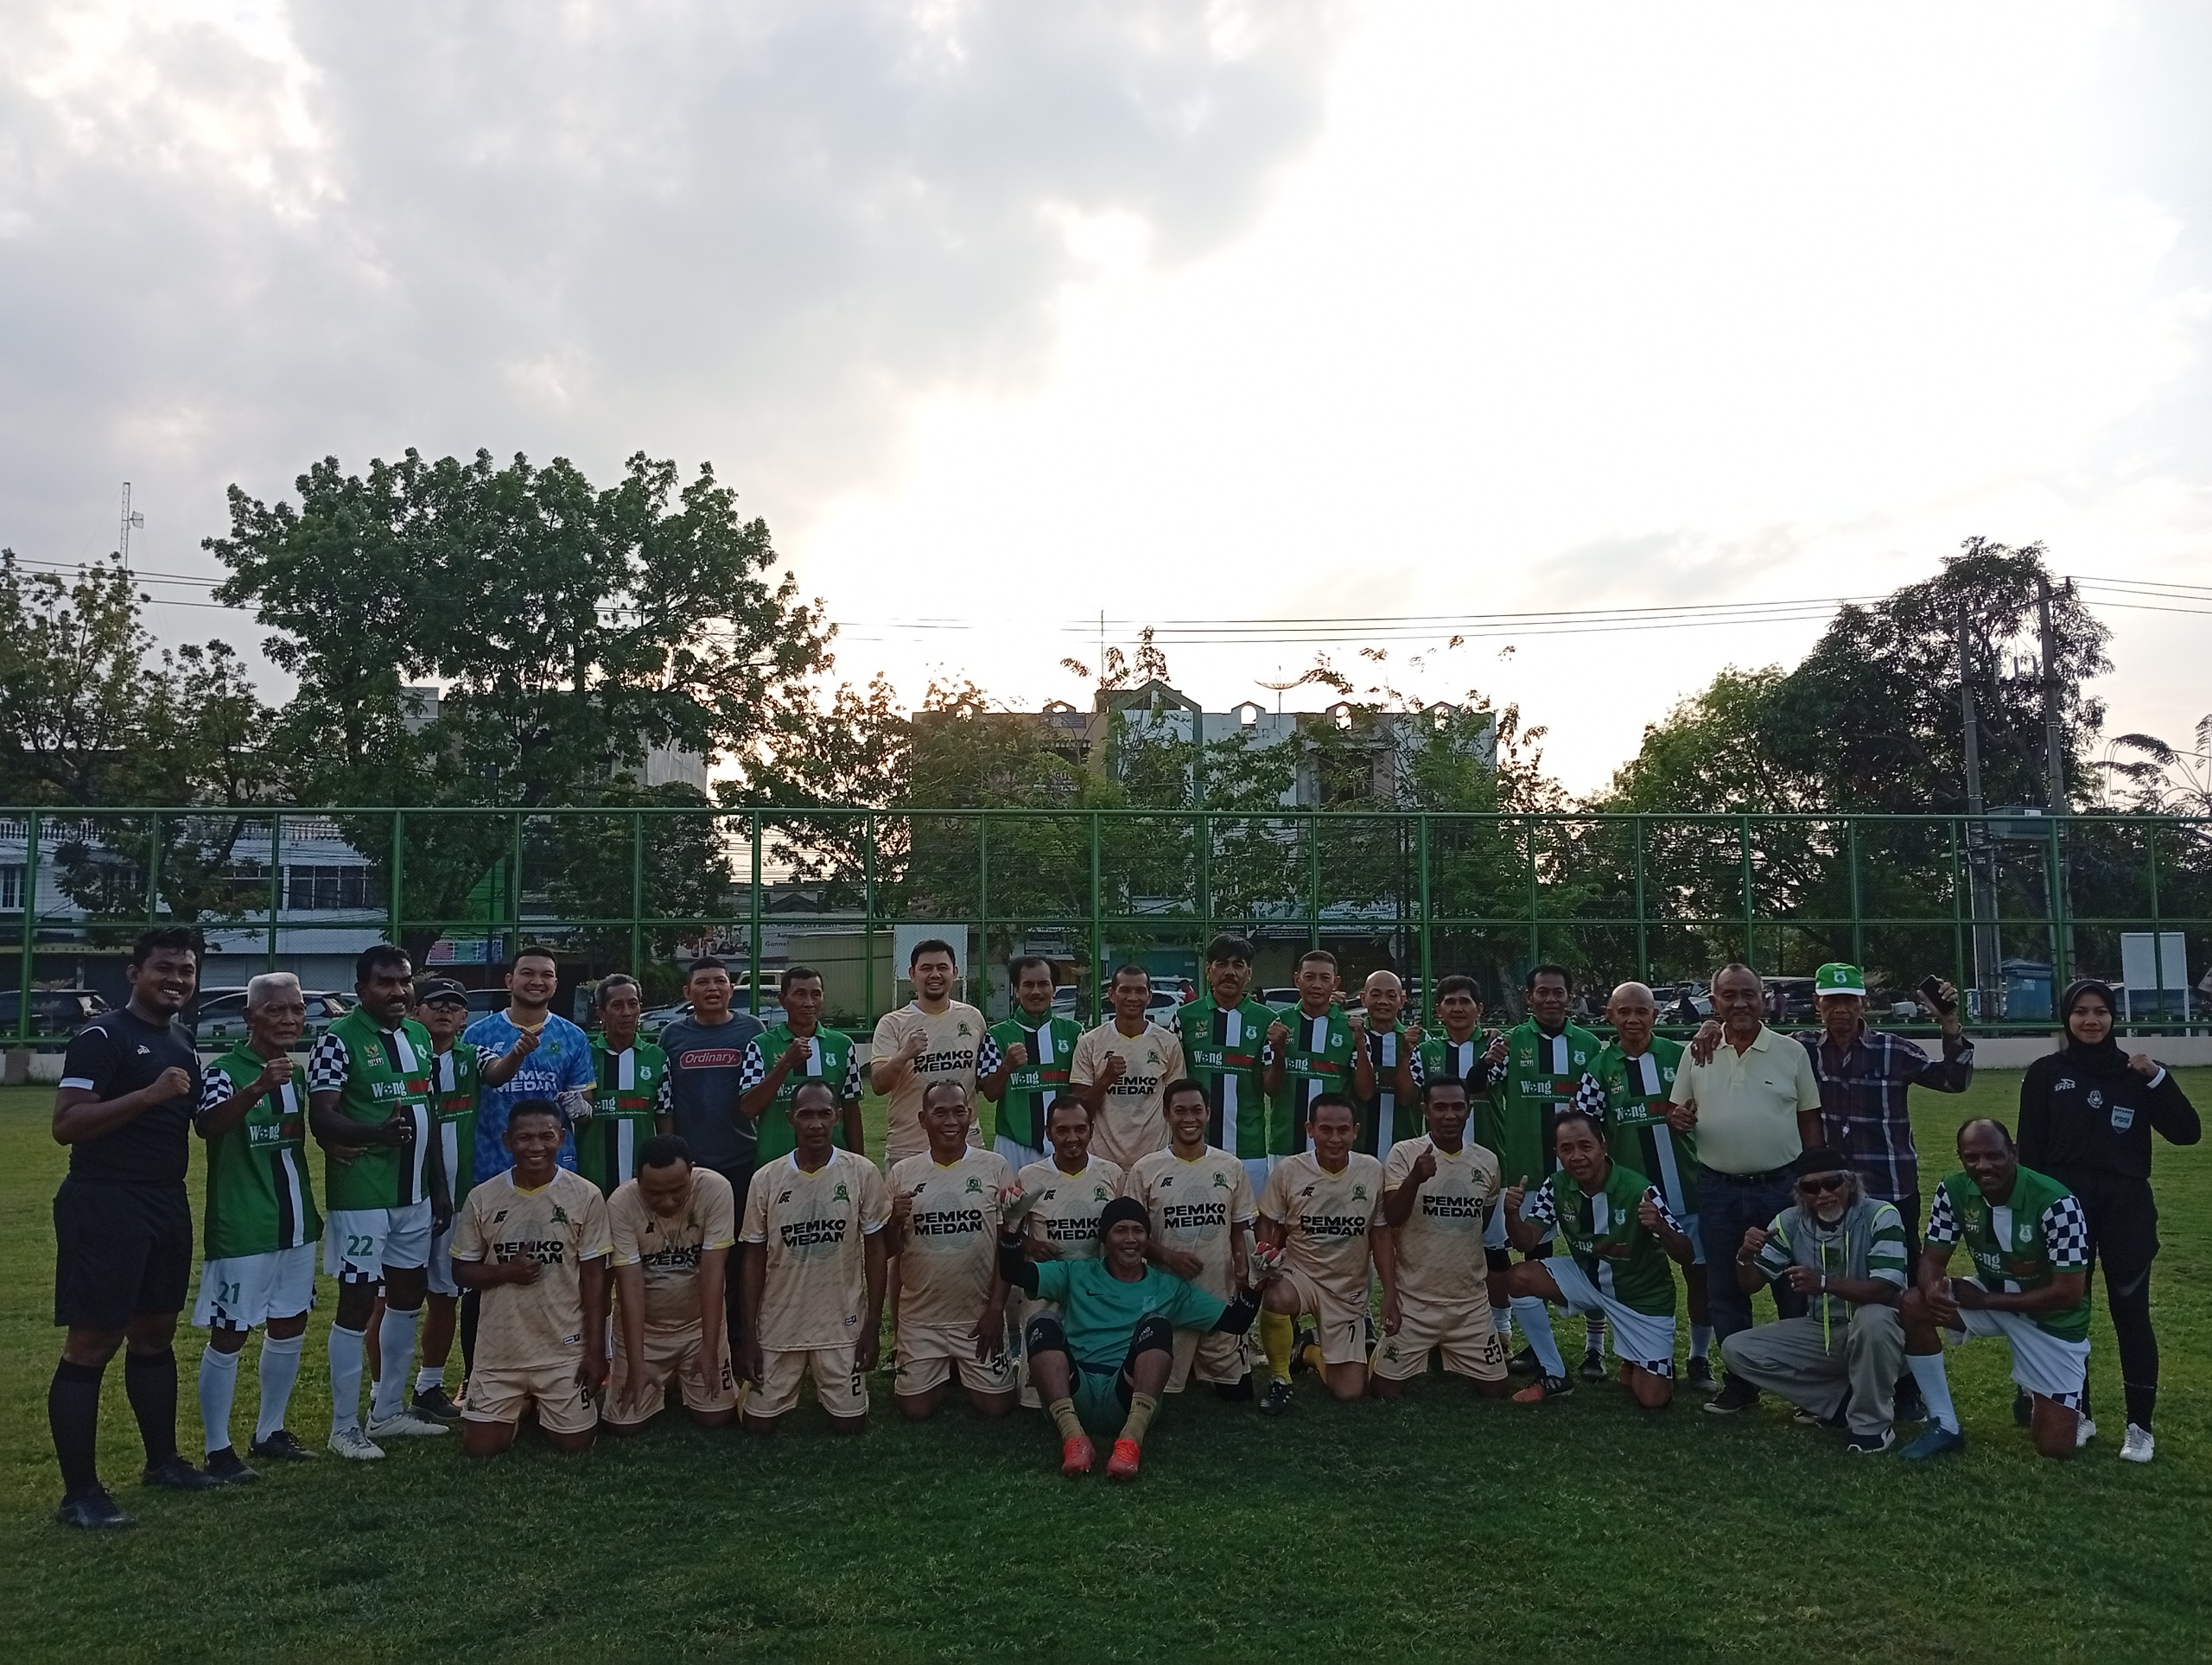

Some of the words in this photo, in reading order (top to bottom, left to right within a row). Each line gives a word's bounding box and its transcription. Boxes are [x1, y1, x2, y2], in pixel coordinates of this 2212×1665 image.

[913, 1049, 974, 1065] PEMKO
[912, 1059, 974, 1074] MEDAN
[512, 1070, 557, 1081] EMKO
[1114, 1076, 1159, 1086] EMKO
[493, 1080, 557, 1093] MEDAN
[594, 1096, 616, 1112] ong
[2113, 1115, 2130, 1124] PSSI
[1423, 1195, 1484, 1207] PEMKO
[912, 1209, 982, 1224] PEMKO
[1163, 1203, 1227, 1217] PEMKO
[1423, 1206, 1482, 1218] MEDAN
[780, 1218, 847, 1236] PEMKO
[914, 1220, 982, 1236] MEDAN
[1046, 1217, 1101, 1230] PEMK
[1164, 1214, 1226, 1230] MEDAN
[1300, 1216, 1366, 1227] PEMKO
[1046, 1229, 1100, 1241] MEDA
[1300, 1225, 1365, 1236] MEDAN
[346, 1235, 373, 1256] 22
[782, 1230, 845, 1248] MEDAN
[496, 1252, 563, 1265] MAN
[218, 1281, 240, 1304] 21
[1483, 1344, 1503, 1366] 23
[993, 1353, 1010, 1376] 24
[851, 1375, 861, 1397] 2
